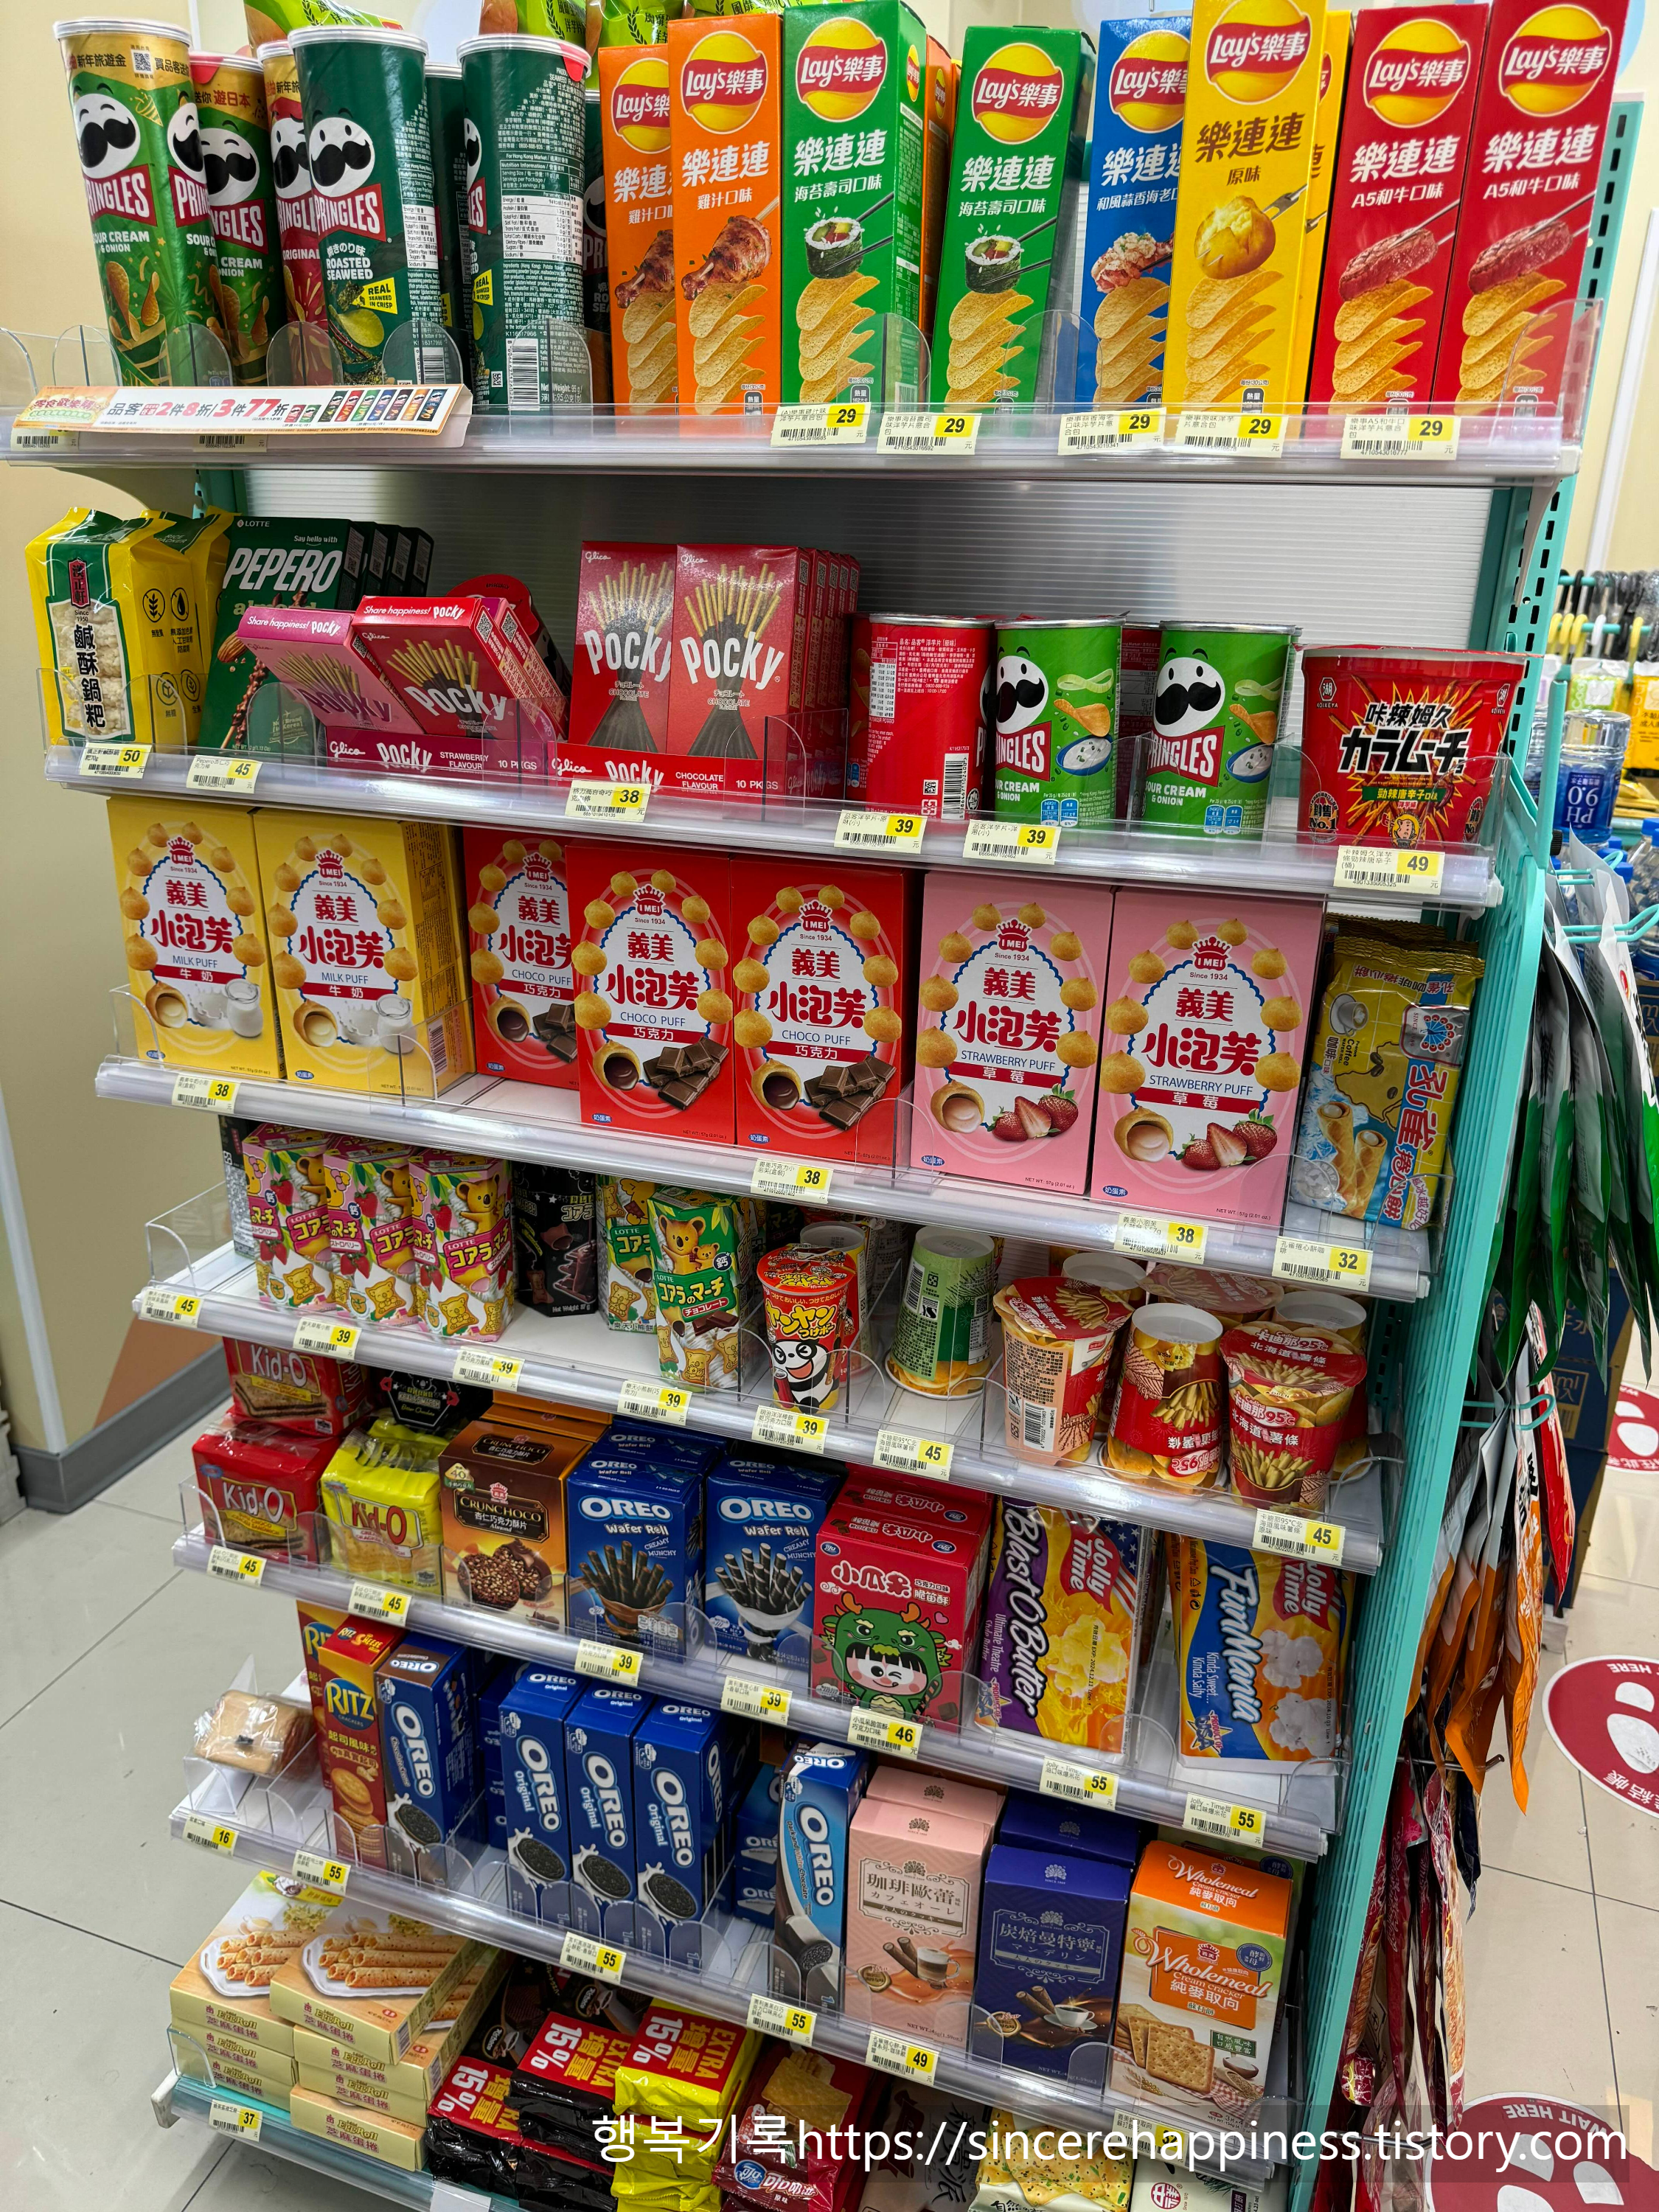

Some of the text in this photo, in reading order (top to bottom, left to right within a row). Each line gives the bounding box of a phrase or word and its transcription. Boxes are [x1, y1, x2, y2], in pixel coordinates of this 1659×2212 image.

[213, 89, 251, 108] 遊日本
[793, 130, 887, 178] 樂連連
[682, 141, 771, 187] 樂連連
[960, 155, 1057, 192] 樂連連
[1226, 165, 1262, 187] 原味
[794, 173, 883, 203] 海苔壽司口味
[1483, 172, 1580, 201] A5和牛口味
[696, 187, 754, 210] 雞汁口味
[1351, 181, 1444, 209] A5和牛口味
[313, 191, 380, 234] PRINGLES
[958, 198, 1047, 218] 海苔壽司口味
[109, 231, 150, 244] CREAM
[326, 257, 371, 270] ROASTED
[326, 268, 373, 280] SEAWEED
[368, 284, 392, 296] REAL
[369, 293, 392, 302] SEAWEED
[836, 408, 856, 423] 29
[1129, 415, 1150, 430] 29
[945, 418, 965, 434] 29
[1248, 418, 1270, 434] 29
[1419, 420, 1442, 437] 29
[245, 520, 271, 528] LOTTE
[294, 535, 338, 546] Say hello with
[585, 550, 612, 561] Glico
[222, 547, 344, 594] PEPERO
[363, 605, 388, 616] Share
[389, 606, 431, 616] happiness!
[247, 616, 267, 627] Share
[268, 618, 310, 631] happiness!
[73, 623, 106, 730] 鹹酥鍋粑
[123, 750, 141, 762] 50
[439, 751, 490, 762] STRAWBERRY
[235, 763, 251, 776] 45
[449, 759, 483, 770] FLAVOUR
[675, 771, 724, 783] CHOCOLATE
[735, 779, 747, 789] 10
[681, 780, 719, 790] FLAVOUR
[1010, 782, 1040, 794] CREAM
[1163, 783, 1207, 799] CREAM
[619, 790, 639, 803] 38
[1004, 793, 1021, 802] ONION
[1158, 796, 1184, 807] ONION
[1377, 787, 1439, 801] 勁辣唐辛子口味
[1565, 804, 1592, 824] PH
[894, 818, 914, 833] 39
[1308, 816, 1338, 832] No.1
[1027, 830, 1046, 844] 39
[184, 866, 198, 874] 1934
[1408, 856, 1429, 872] 49
[164, 879, 209, 908] 義美
[314, 894, 359, 923] 義美
[150, 909, 234, 954] 小泡芙
[298, 925, 384, 969] 小泡芙
[627, 931, 674, 963] 義美
[173, 955, 218, 969] MILK PUFF
[321, 972, 369, 984] MILK PUFF
[605, 966, 700, 1011] 小泡芙
[619, 1011, 686, 1028] CHOCO PUFF
[633, 1026, 674, 1041] 巧克力
[782, 1029, 851, 1046] CHOCO PUFF
[795, 1044, 838, 1060] 巧克力
[1343, 1038, 1354, 1067] Coffee
[960, 1050, 1056, 1071] STRAWBERRY PUFF
[981, 1066, 1025, 1084] 草莓
[215, 1083, 229, 1097] 38
[1148, 1074, 1253, 1097] STRAWBERRY PUFF
[804, 1169, 821, 1185] 38
[614, 1227, 640, 1235] LOTTE
[1176, 1226, 1194, 1243] 38
[448, 1237, 476, 1251] LOTTE
[1338, 1252, 1358, 1270] 32
[658, 1276, 726, 1304] コアラのマーチ
[181, 1300, 194, 1312] 45
[684, 1299, 726, 1317] チョコレート
[336, 1329, 351, 1343] 39
[251, 1343, 307, 1388] Kid-O
[666, 1393, 681, 1407] 39
[801, 1422, 818, 1435] 39
[484, 1437, 547, 1455] CRUNCHOCO
[925, 1445, 942, 1461] 45
[222, 1481, 284, 1523] Kid-O
[459, 1497, 542, 1522] CRUNCHOCO
[489, 1523, 512, 1533] Almond
[603, 1522, 669, 1536] Wafer Roll
[742, 1523, 809, 1537] Wafer Roll
[644, 1537, 669, 1551] CREAMY
[783, 1538, 809, 1553] CREAMY
[647, 1549, 677, 1558] MUNCHY
[787, 1551, 817, 1560] MUNCHY
[245, 1559, 257, 1572] 45
[914, 1579, 950, 1593] 巧克力口味
[389, 1597, 403, 1610] 45
[914, 1590, 951, 1607] 脆笛酥
[338, 1627, 355, 1639] RITZ
[990, 1613, 1006, 1672] Ultimate Theatre
[619, 1654, 633, 1669] 39
[1607, 1663, 1652, 1674] HERE
[527, 1672, 577, 1686] OREO
[544, 1683, 568, 1691] Original
[1188, 1680, 1201, 1698] Salty
[325, 1682, 375, 1721] RITZ
[592, 1688, 642, 1703] OREO
[767, 1693, 782, 1707] 39
[661, 1704, 712, 1718] OREO
[894, 1727, 914, 1742] 46
[1091, 1775, 1107, 1791] 55
[515, 1770, 532, 1813] Original
[1238, 1811, 1255, 1829] 55
[219, 1830, 230, 1845] 16
[328, 1865, 342, 1879] 55
[1167, 1854, 1260, 1899] Wholemeal
[870, 1891, 956, 1916] カフェオーレ
[602, 1952, 617, 1967] 55
[1011, 1942, 1086, 1962] マンデリン
[1173, 1972, 1246, 1999] Cream cracker
[1169, 1978, 1239, 2012] 純麥取向
[206, 2015, 259, 2041] 芝麻蛋捲
[791, 2013, 807, 2029] 55
[661, 2017, 711, 2076] 增量
[913, 2051, 928, 2067] 49
[243, 2112, 255, 2125] 37
[1505, 2105, 1551, 2121] HERE
